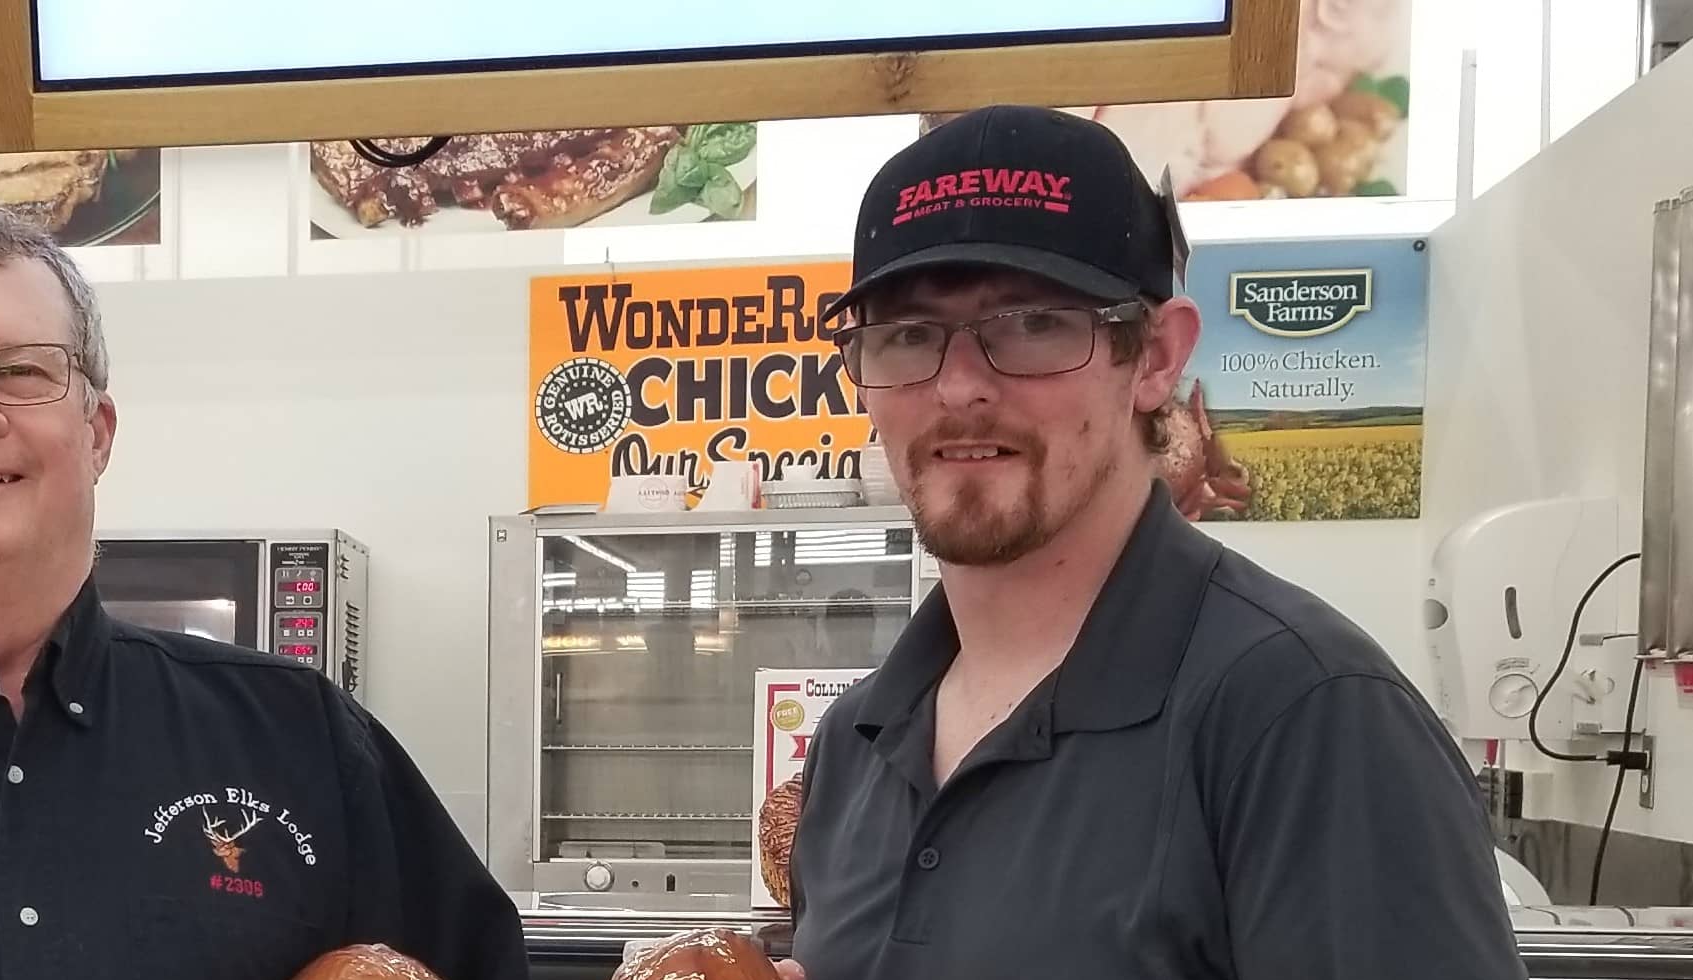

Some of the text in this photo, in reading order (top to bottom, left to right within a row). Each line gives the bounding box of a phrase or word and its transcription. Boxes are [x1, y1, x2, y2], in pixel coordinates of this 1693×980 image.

[895, 168, 1071, 212] FAREWAY
[914, 201, 951, 218] MEAT
[970, 196, 1042, 208] GROCERY
[1244, 280, 1358, 303] Sanderson
[1266, 302, 1336, 323] Farms
[1222, 349, 1381, 372] 100% Chicken.
[543, 365, 616, 410] GENUINE
[563, 391, 604, 421] WR
[626, 352, 868, 428] CHICK
[1251, 377, 1355, 402] Naturally.
[544, 389, 625, 446] ROTISSERIED
[707, 426, 878, 482] Specia
[144, 786, 316, 866] Jefferson Elks Lodge
